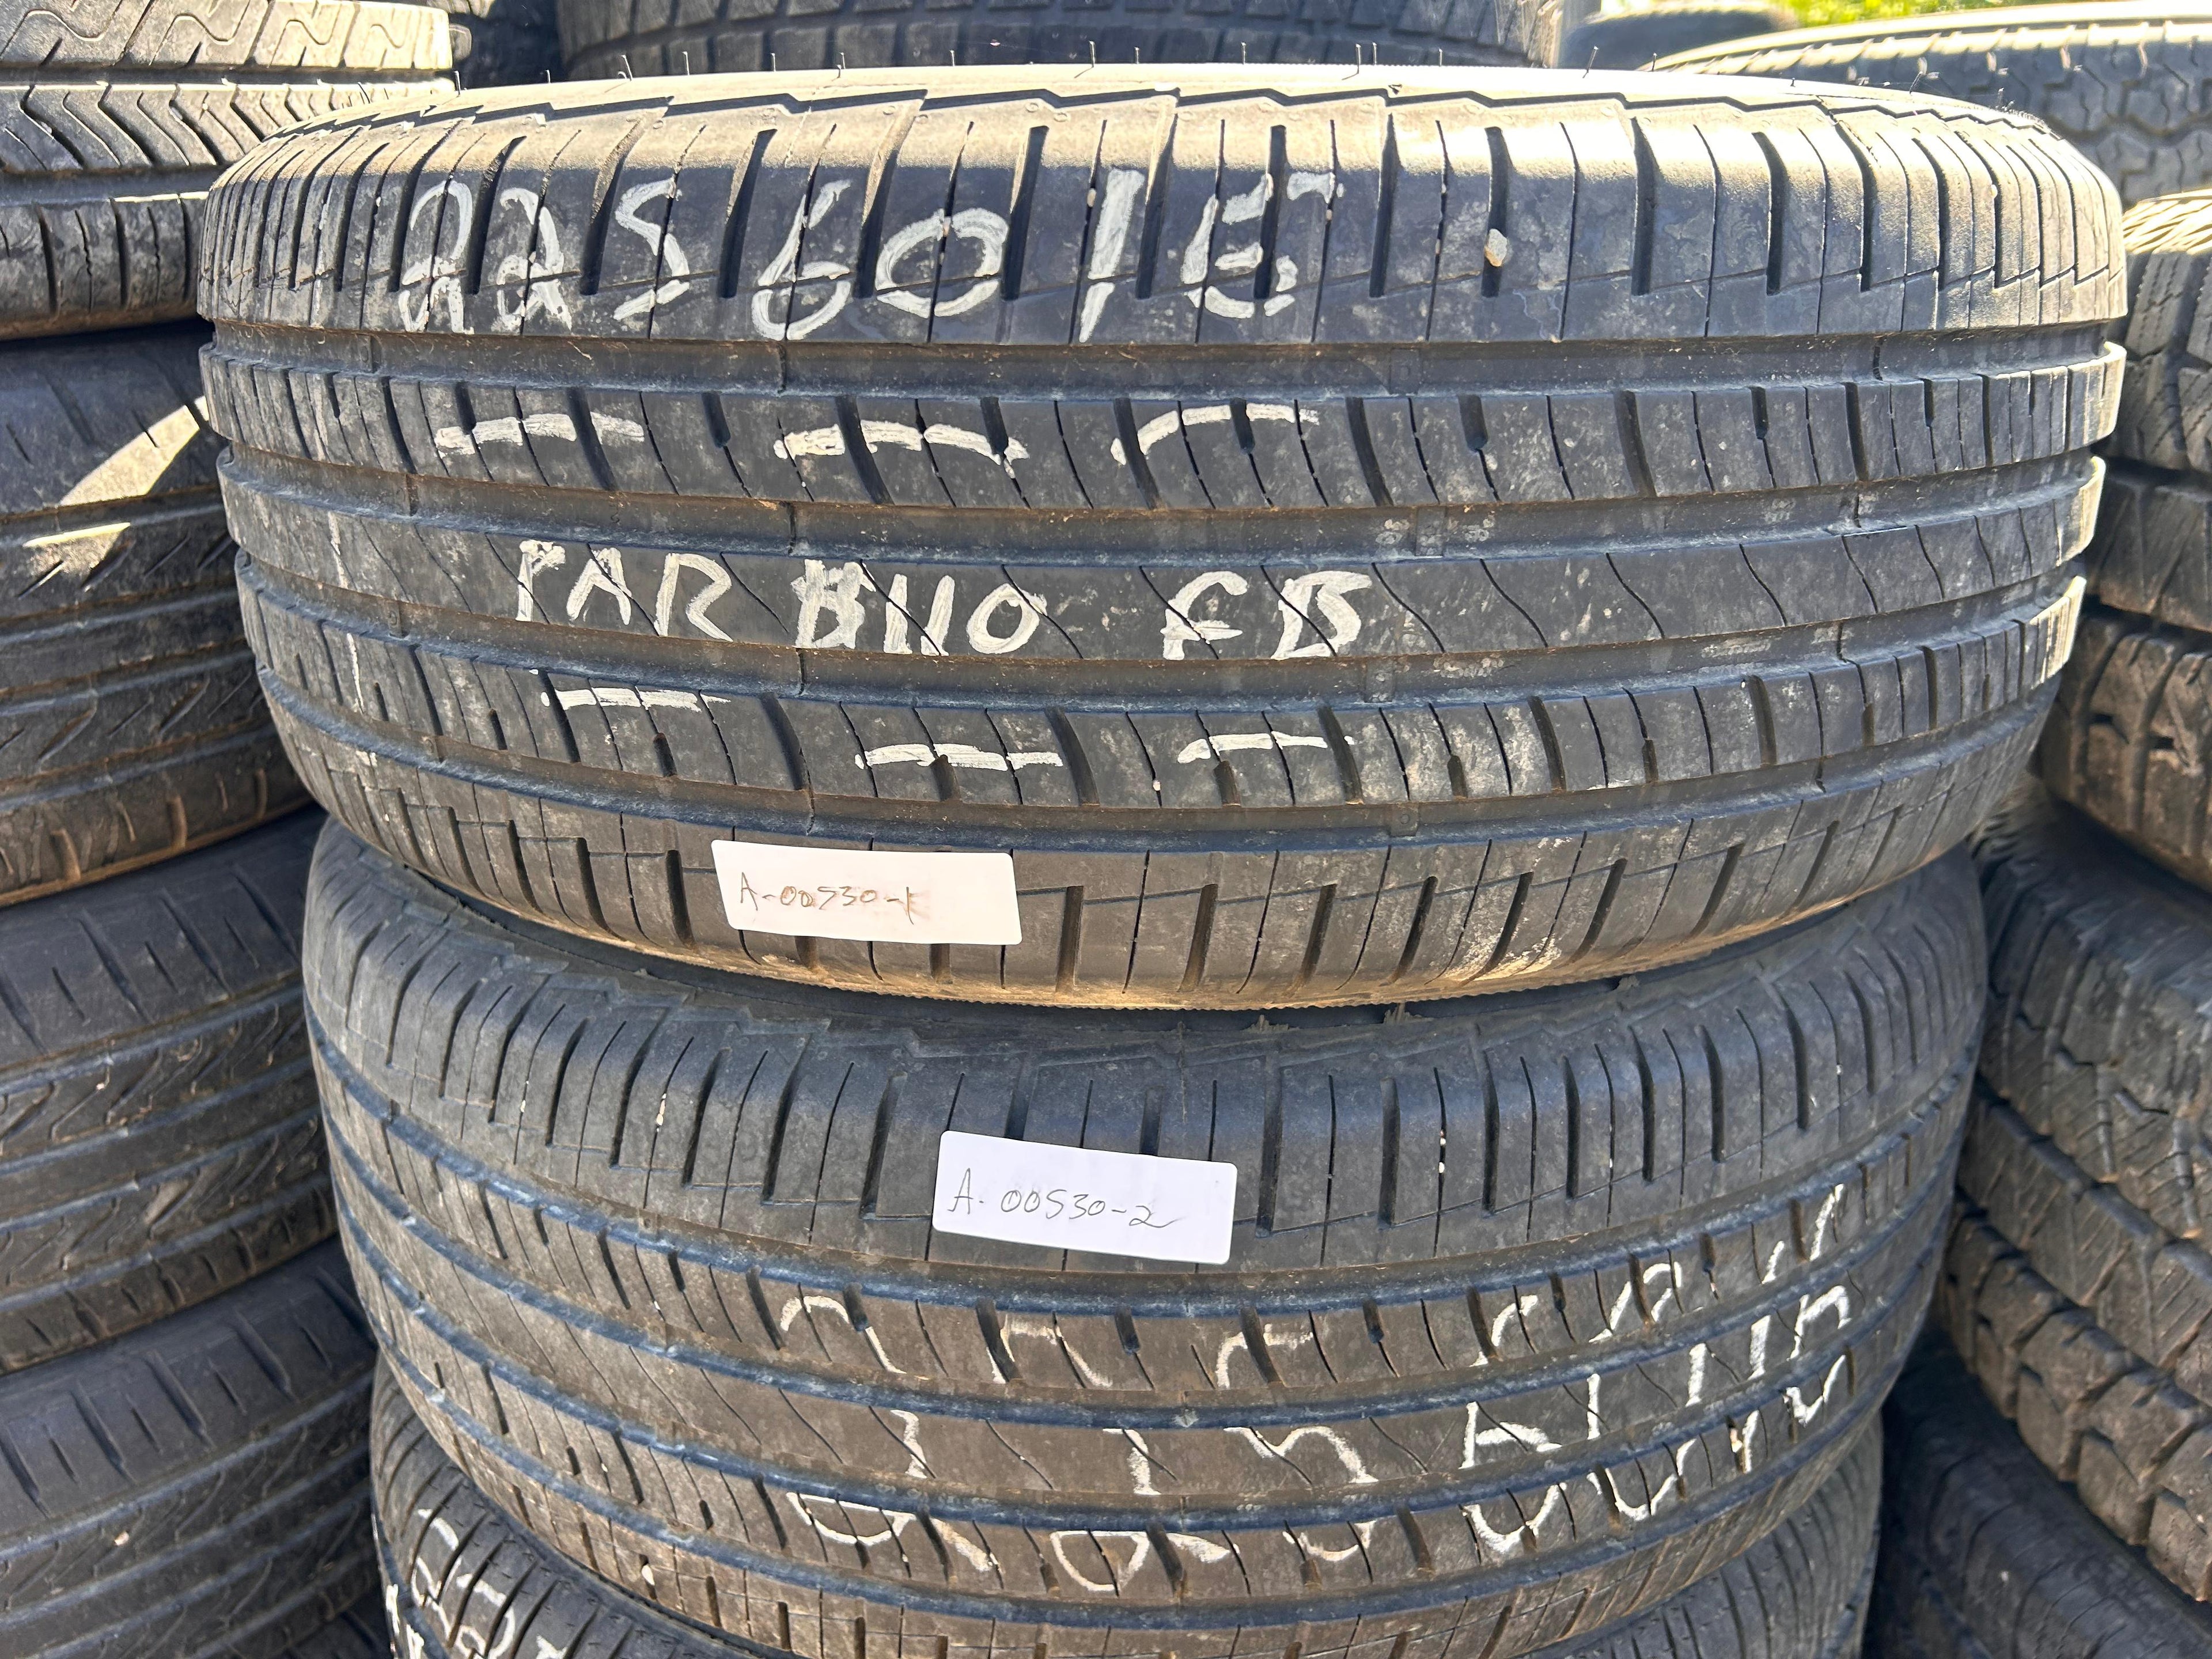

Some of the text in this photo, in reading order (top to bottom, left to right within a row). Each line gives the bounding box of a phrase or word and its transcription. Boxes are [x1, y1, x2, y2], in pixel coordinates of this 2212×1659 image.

[397, 176, 691, 335] 225
[751, 179, 1009, 342] 60
[516, 539, 733, 642] PAR
